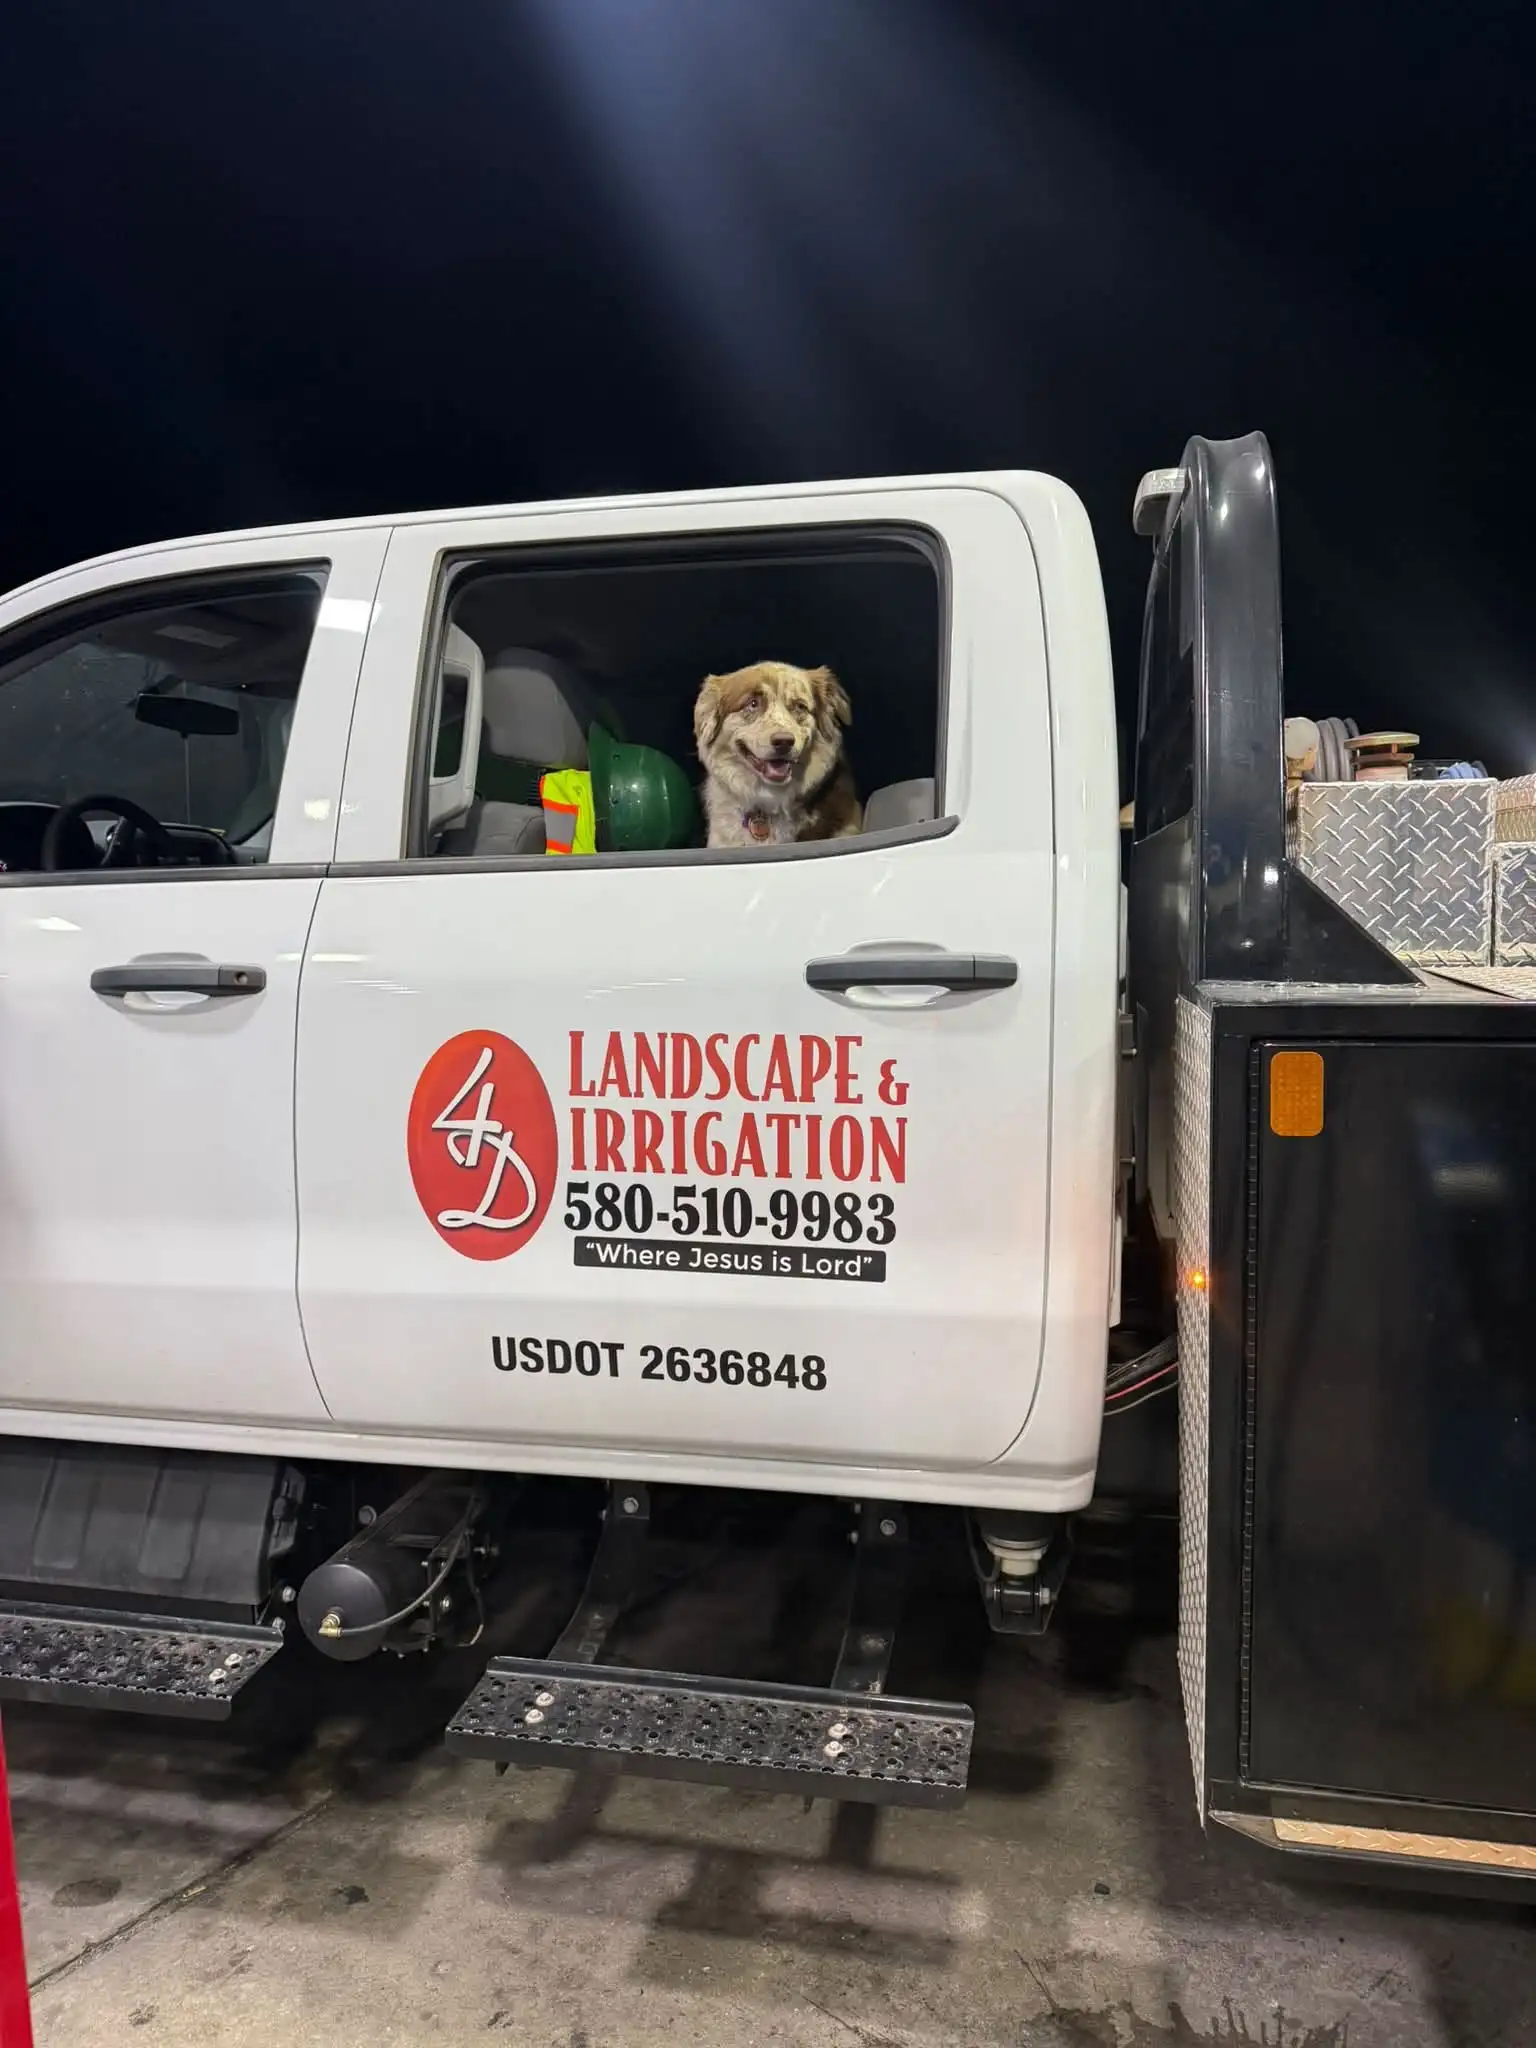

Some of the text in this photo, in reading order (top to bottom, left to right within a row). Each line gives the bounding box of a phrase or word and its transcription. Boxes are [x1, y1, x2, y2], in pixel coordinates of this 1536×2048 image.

[568, 1030, 910, 1106] LANDSCAPE &
[570, 1107, 908, 1184] IRRIGATION
[564, 1180, 897, 1245] 580-510-9983
[689, 1247, 763, 1272] Jesus
[772, 1250, 792, 1273] is
[491, 1335, 828, 1392] USDOT 2636848
